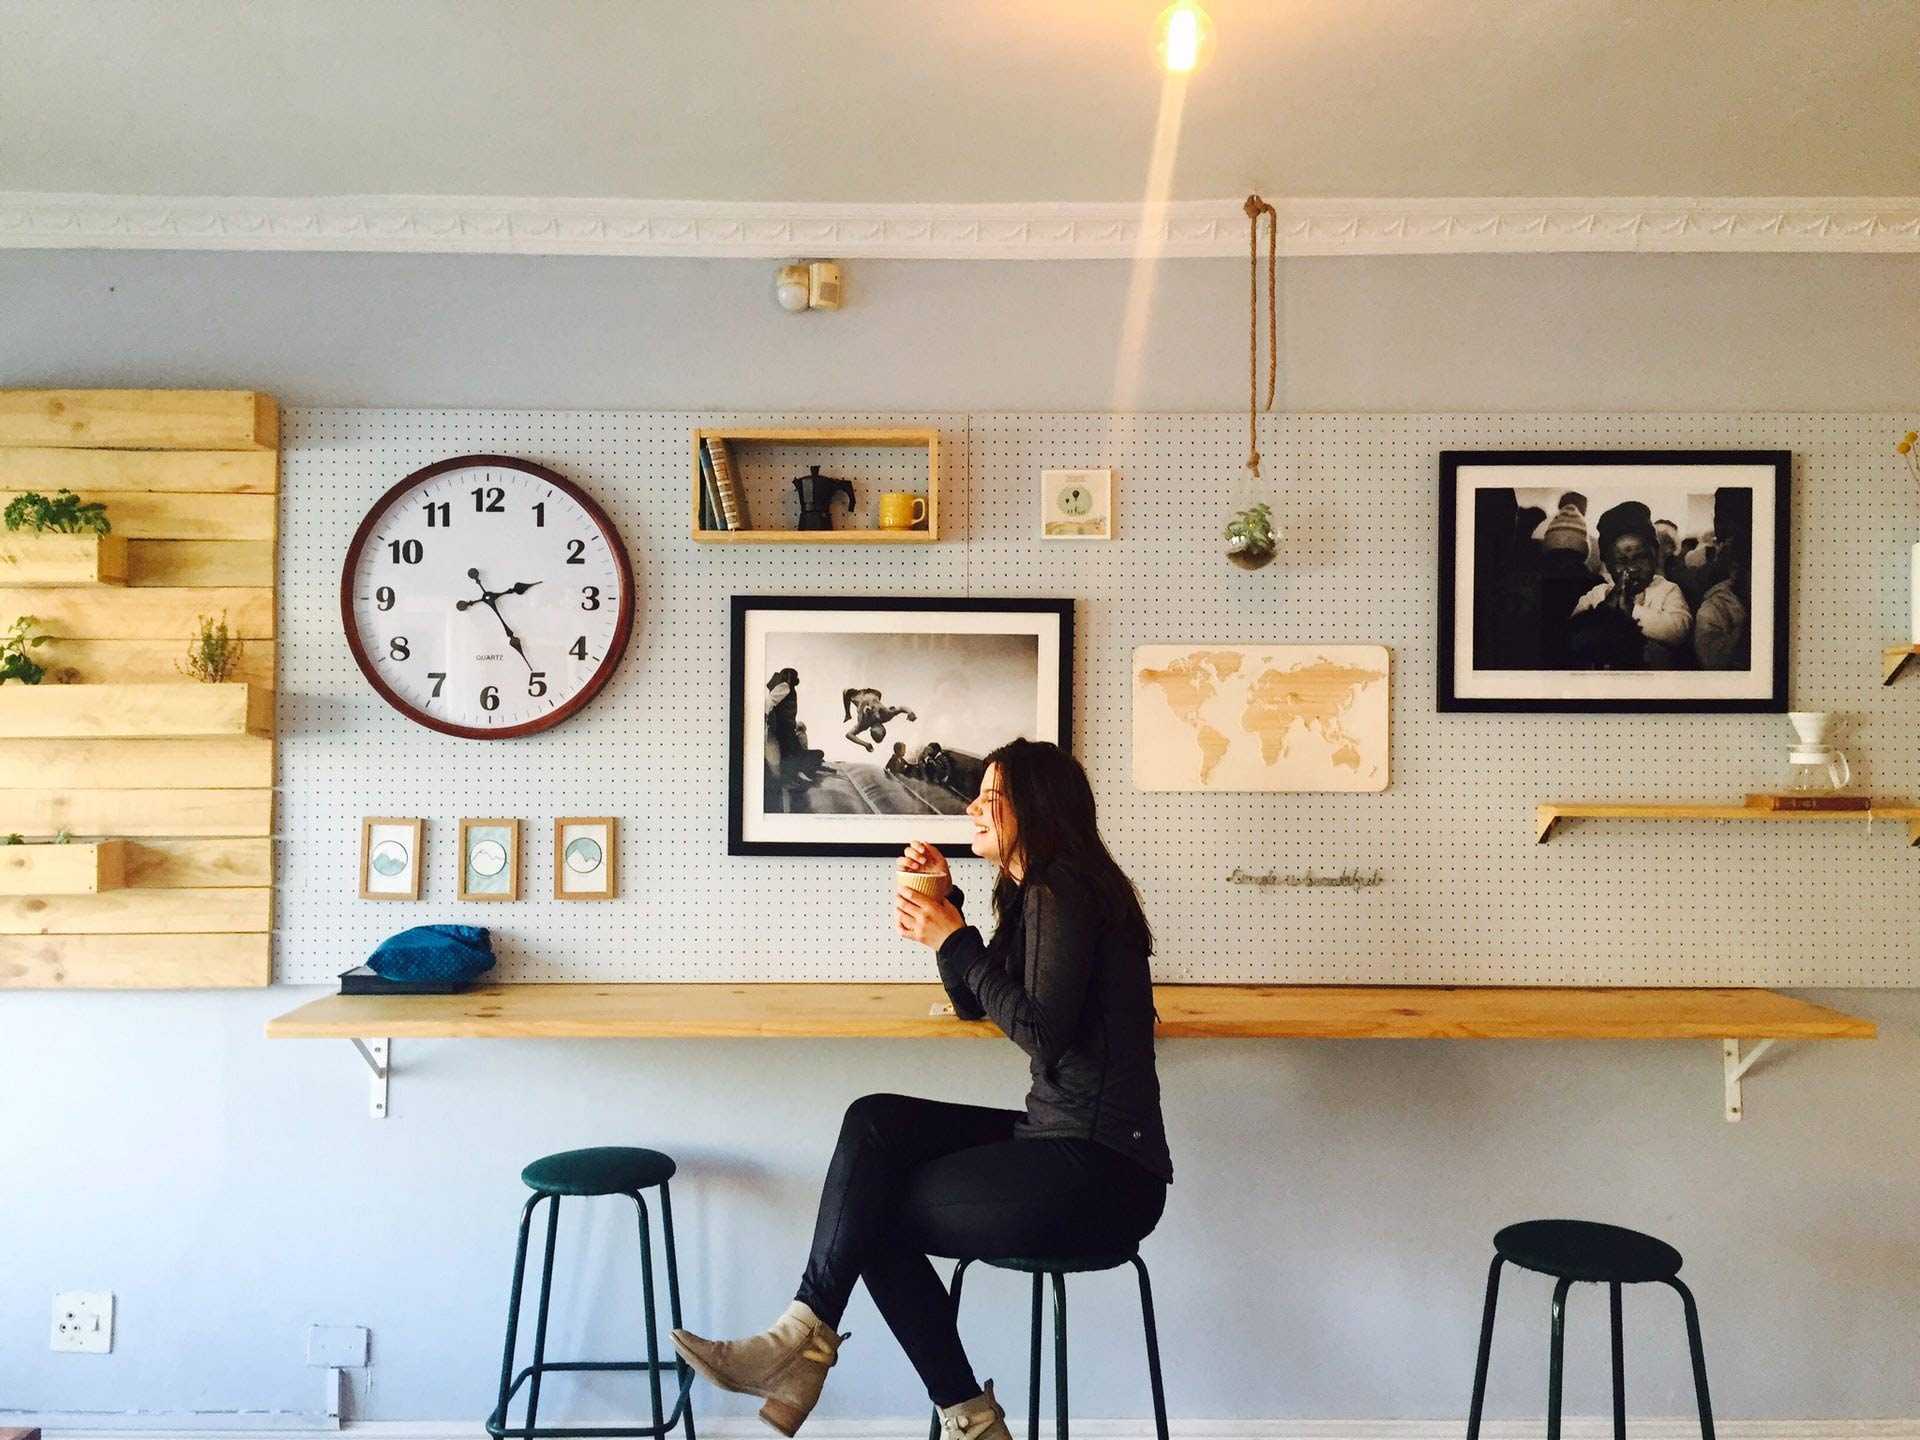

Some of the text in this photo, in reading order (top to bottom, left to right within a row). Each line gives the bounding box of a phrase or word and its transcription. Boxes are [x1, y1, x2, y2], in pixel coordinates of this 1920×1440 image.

[471, 488, 505, 512] 12
[423, 502, 450, 527] 11
[532, 502, 545, 527] 1
[388, 540, 423, 564] 10
[566, 540, 585, 564] 2
[376, 586, 395, 611] 9
[581, 586, 600, 610] 3
[390, 636, 410, 661] 8
[569, 636, 588, 660] 4
[427, 673, 446, 697] 7
[528, 672, 547, 697] 5
[480, 686, 499, 711] 6
